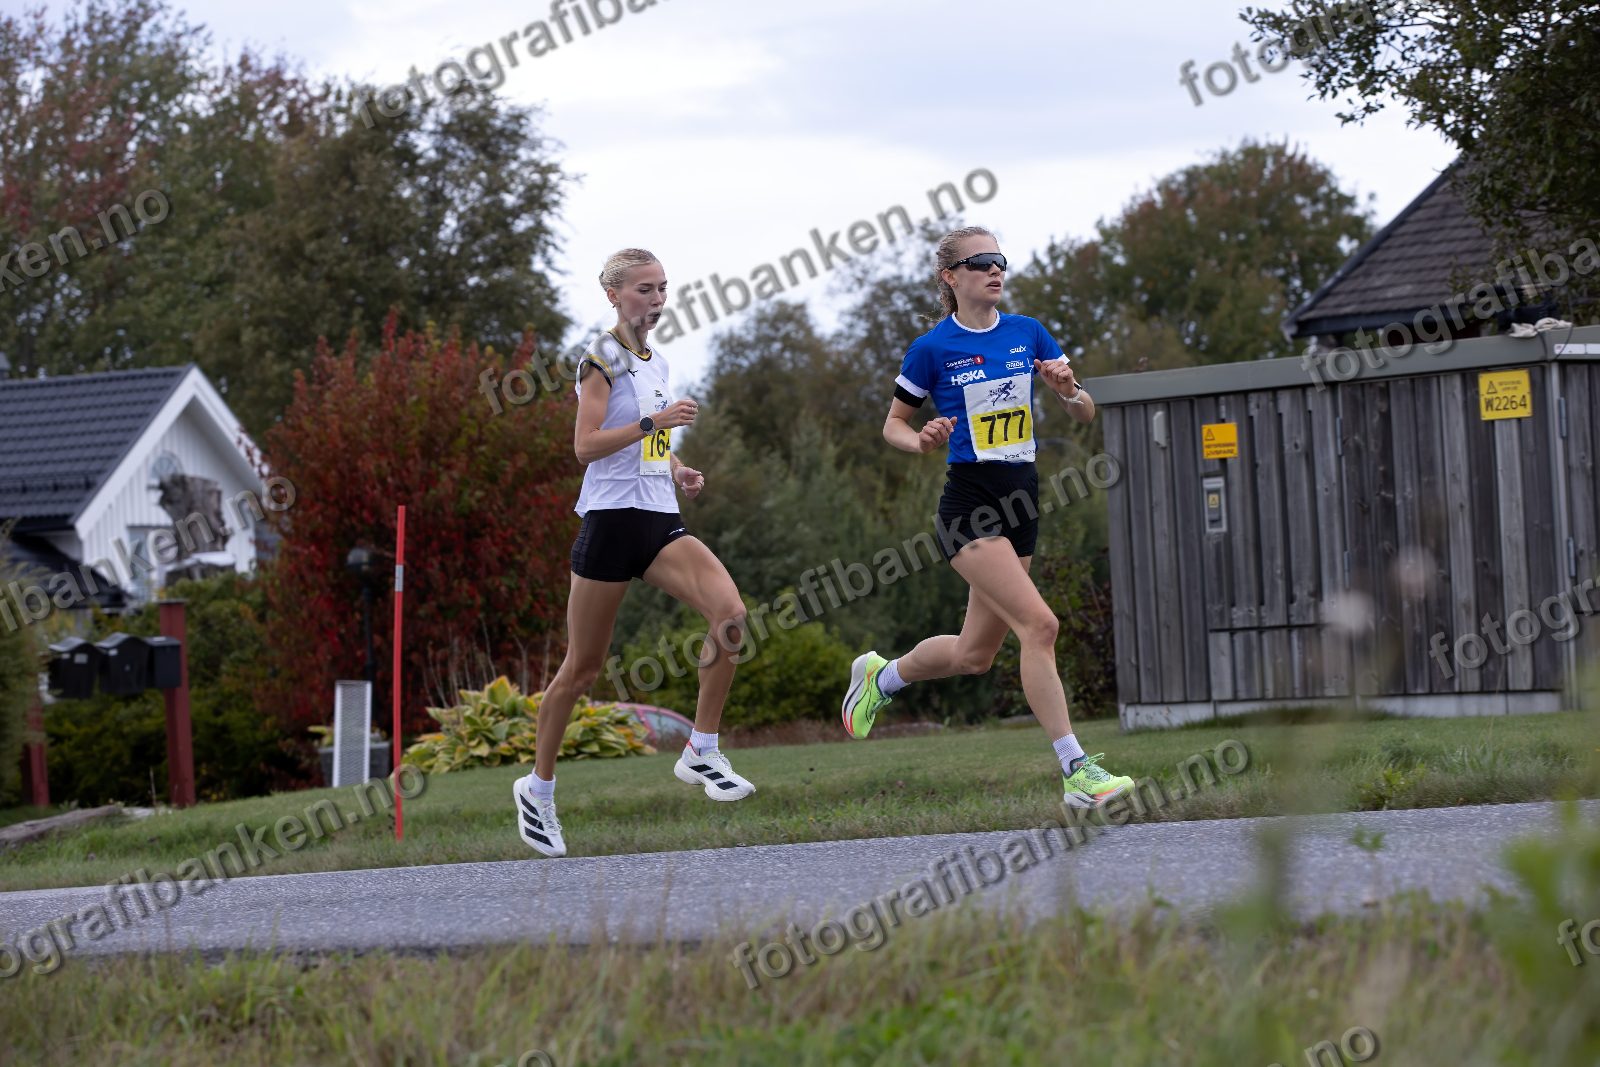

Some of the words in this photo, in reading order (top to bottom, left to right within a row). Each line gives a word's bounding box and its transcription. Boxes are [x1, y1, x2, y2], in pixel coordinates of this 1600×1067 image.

[951, 370, 987, 386] HOKA
[1484, 394, 1528, 412] W2264
[980, 409, 1025, 444] 777
